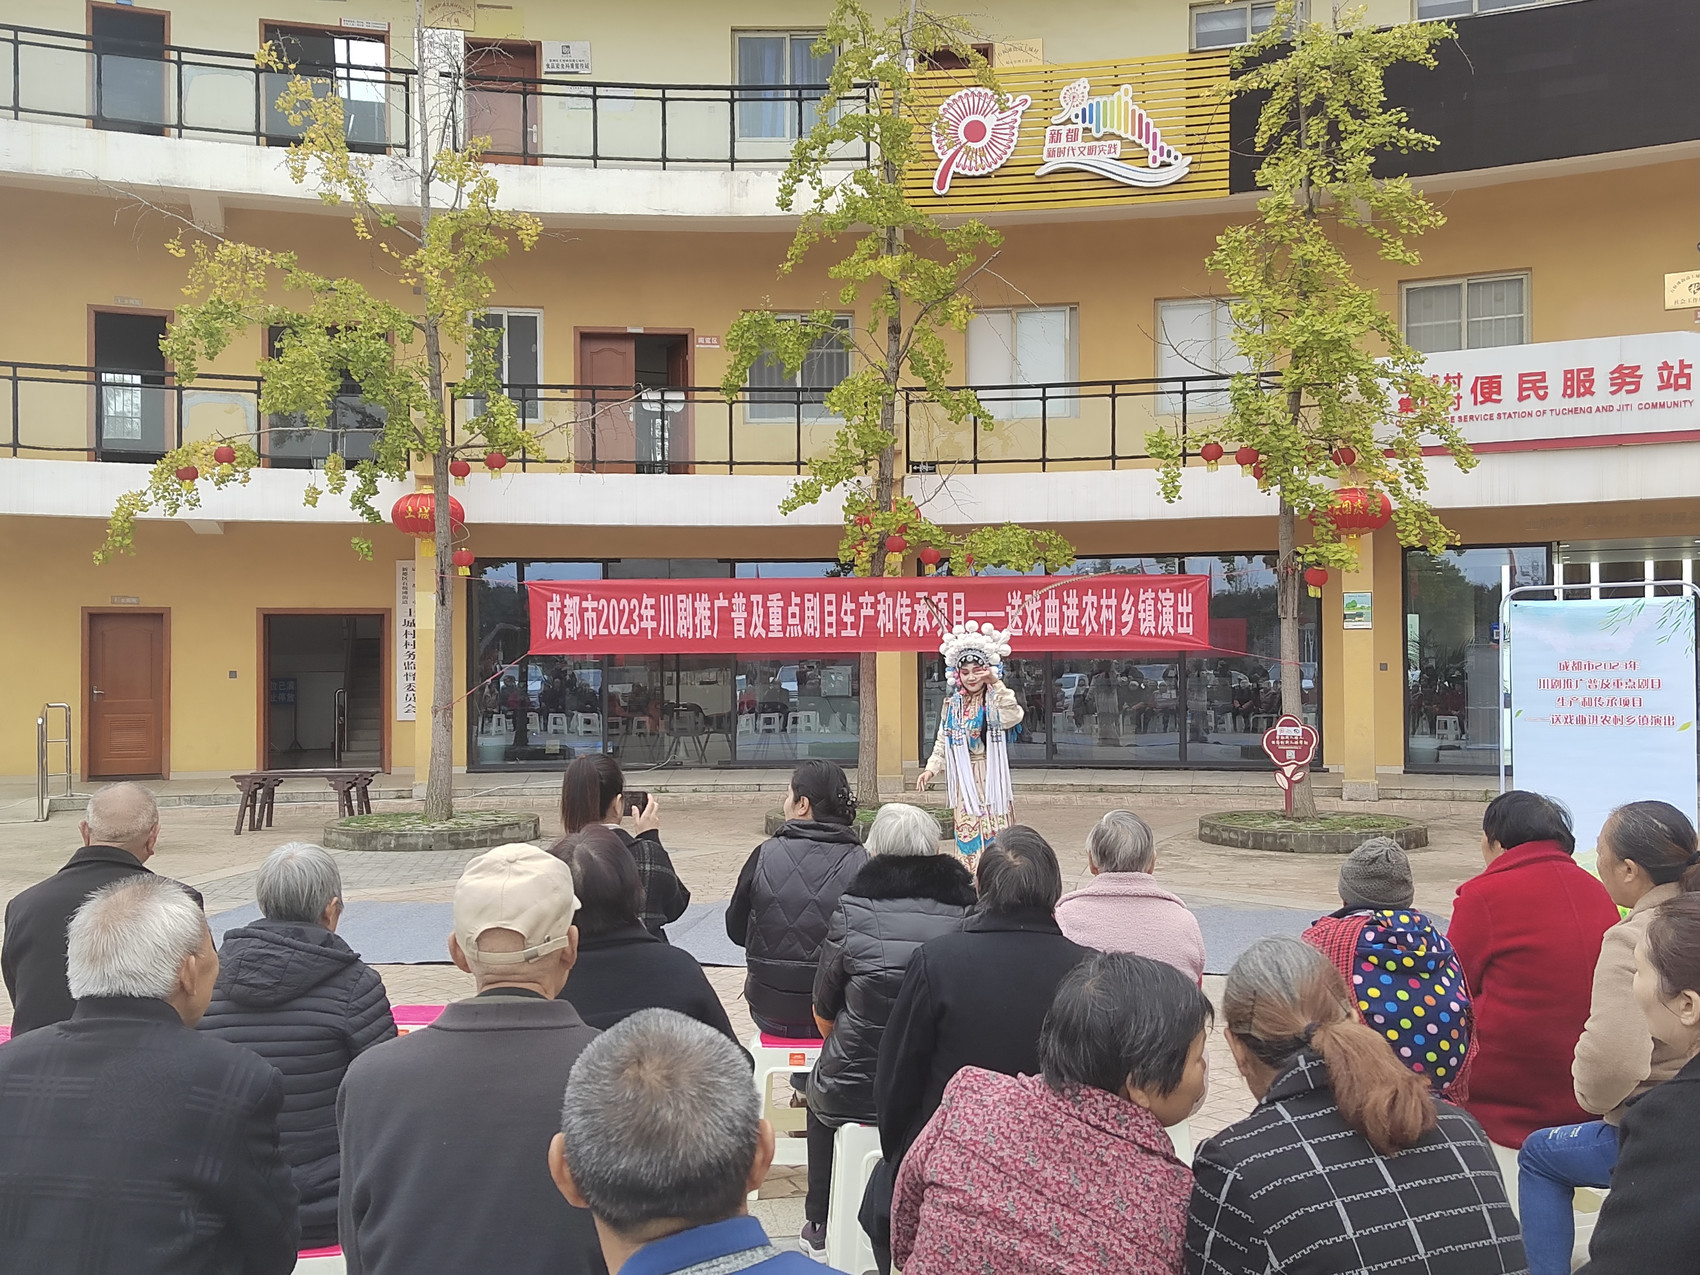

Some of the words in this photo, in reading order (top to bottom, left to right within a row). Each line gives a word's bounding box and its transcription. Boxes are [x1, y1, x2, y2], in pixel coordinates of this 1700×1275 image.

[1048, 127, 1080, 144] 新都
[1046, 143, 1118, 158] 新时代文明实践
[1470, 358, 1693, 407] 便民服务站
[1457, 412, 1494, 423] SERVICE
[1496, 410, 1533, 421] STATION
[1535, 409, 1547, 418] OF
[1549, 406, 1593, 417] TUCHENG
[1594, 404, 1614, 413] AND
[1616, 403, 1633, 412] JITI
[1637, 399, 1695, 411] COMMUNITY
[1558, 660, 1640, 672] 成都市2023年
[1538, 678, 1662, 690] 川剧推广普及重点剧目
[1556, 696, 1643, 708] 生产和传承项目
